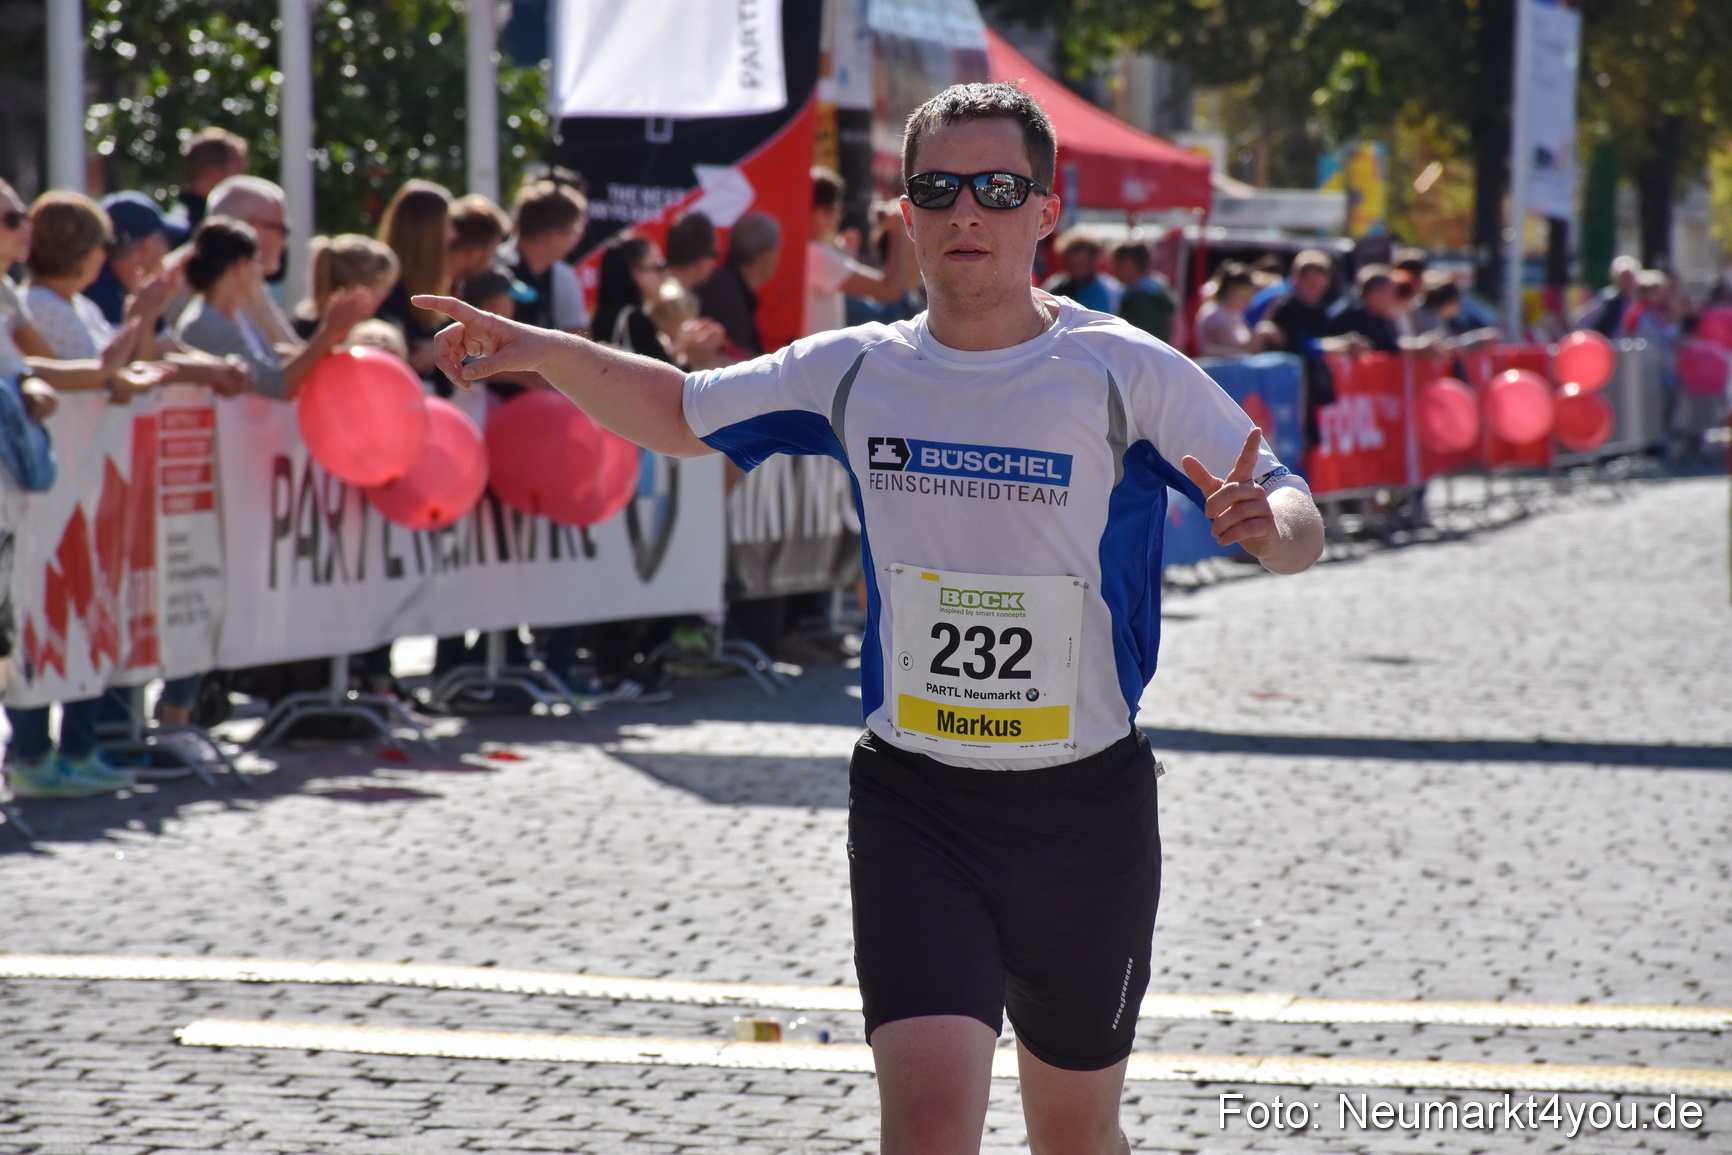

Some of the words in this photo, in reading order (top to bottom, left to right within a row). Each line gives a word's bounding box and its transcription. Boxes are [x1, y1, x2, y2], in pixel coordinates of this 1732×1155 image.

[920, 446, 1063, 480] BÜSCHEL
[869, 472, 1069, 507] FEINSCHNEIDTEAM
[939, 607, 965, 617] inspired
[965, 609, 974, 617] by
[996, 611, 1026, 619] concepts
[940, 587, 1025, 612] BOCK
[930, 622, 1033, 680] 232
[926, 682, 961, 699] PARTL
[964, 689, 1022, 701] Neumarkt
[937, 709, 1022, 737] Markus
